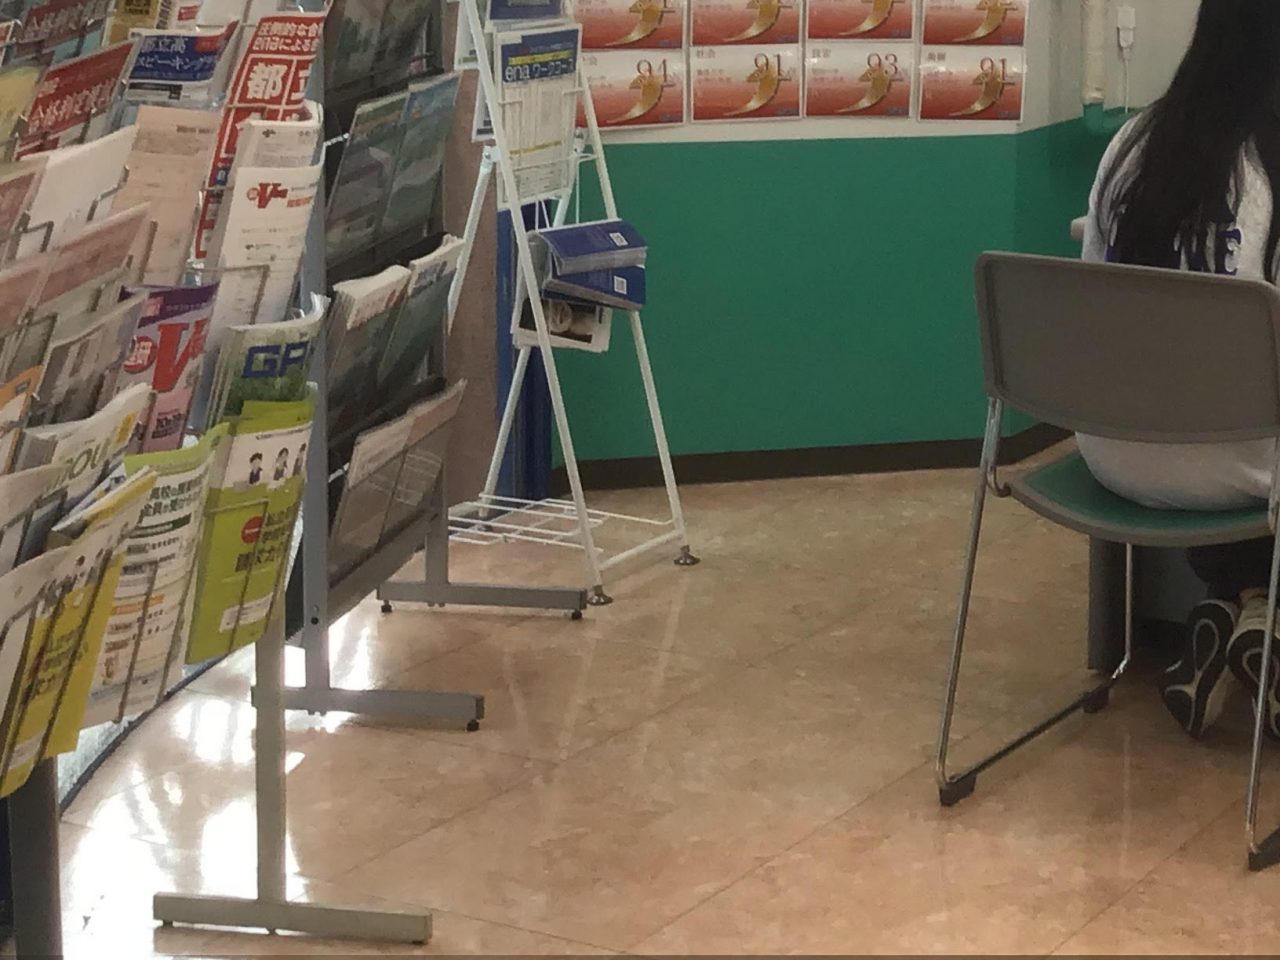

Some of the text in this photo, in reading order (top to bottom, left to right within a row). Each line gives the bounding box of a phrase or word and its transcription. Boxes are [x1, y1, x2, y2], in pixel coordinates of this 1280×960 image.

[754, 53, 782, 78] 91
[867, 53, 898, 76] 93
[980, 57, 1008, 81] 91
